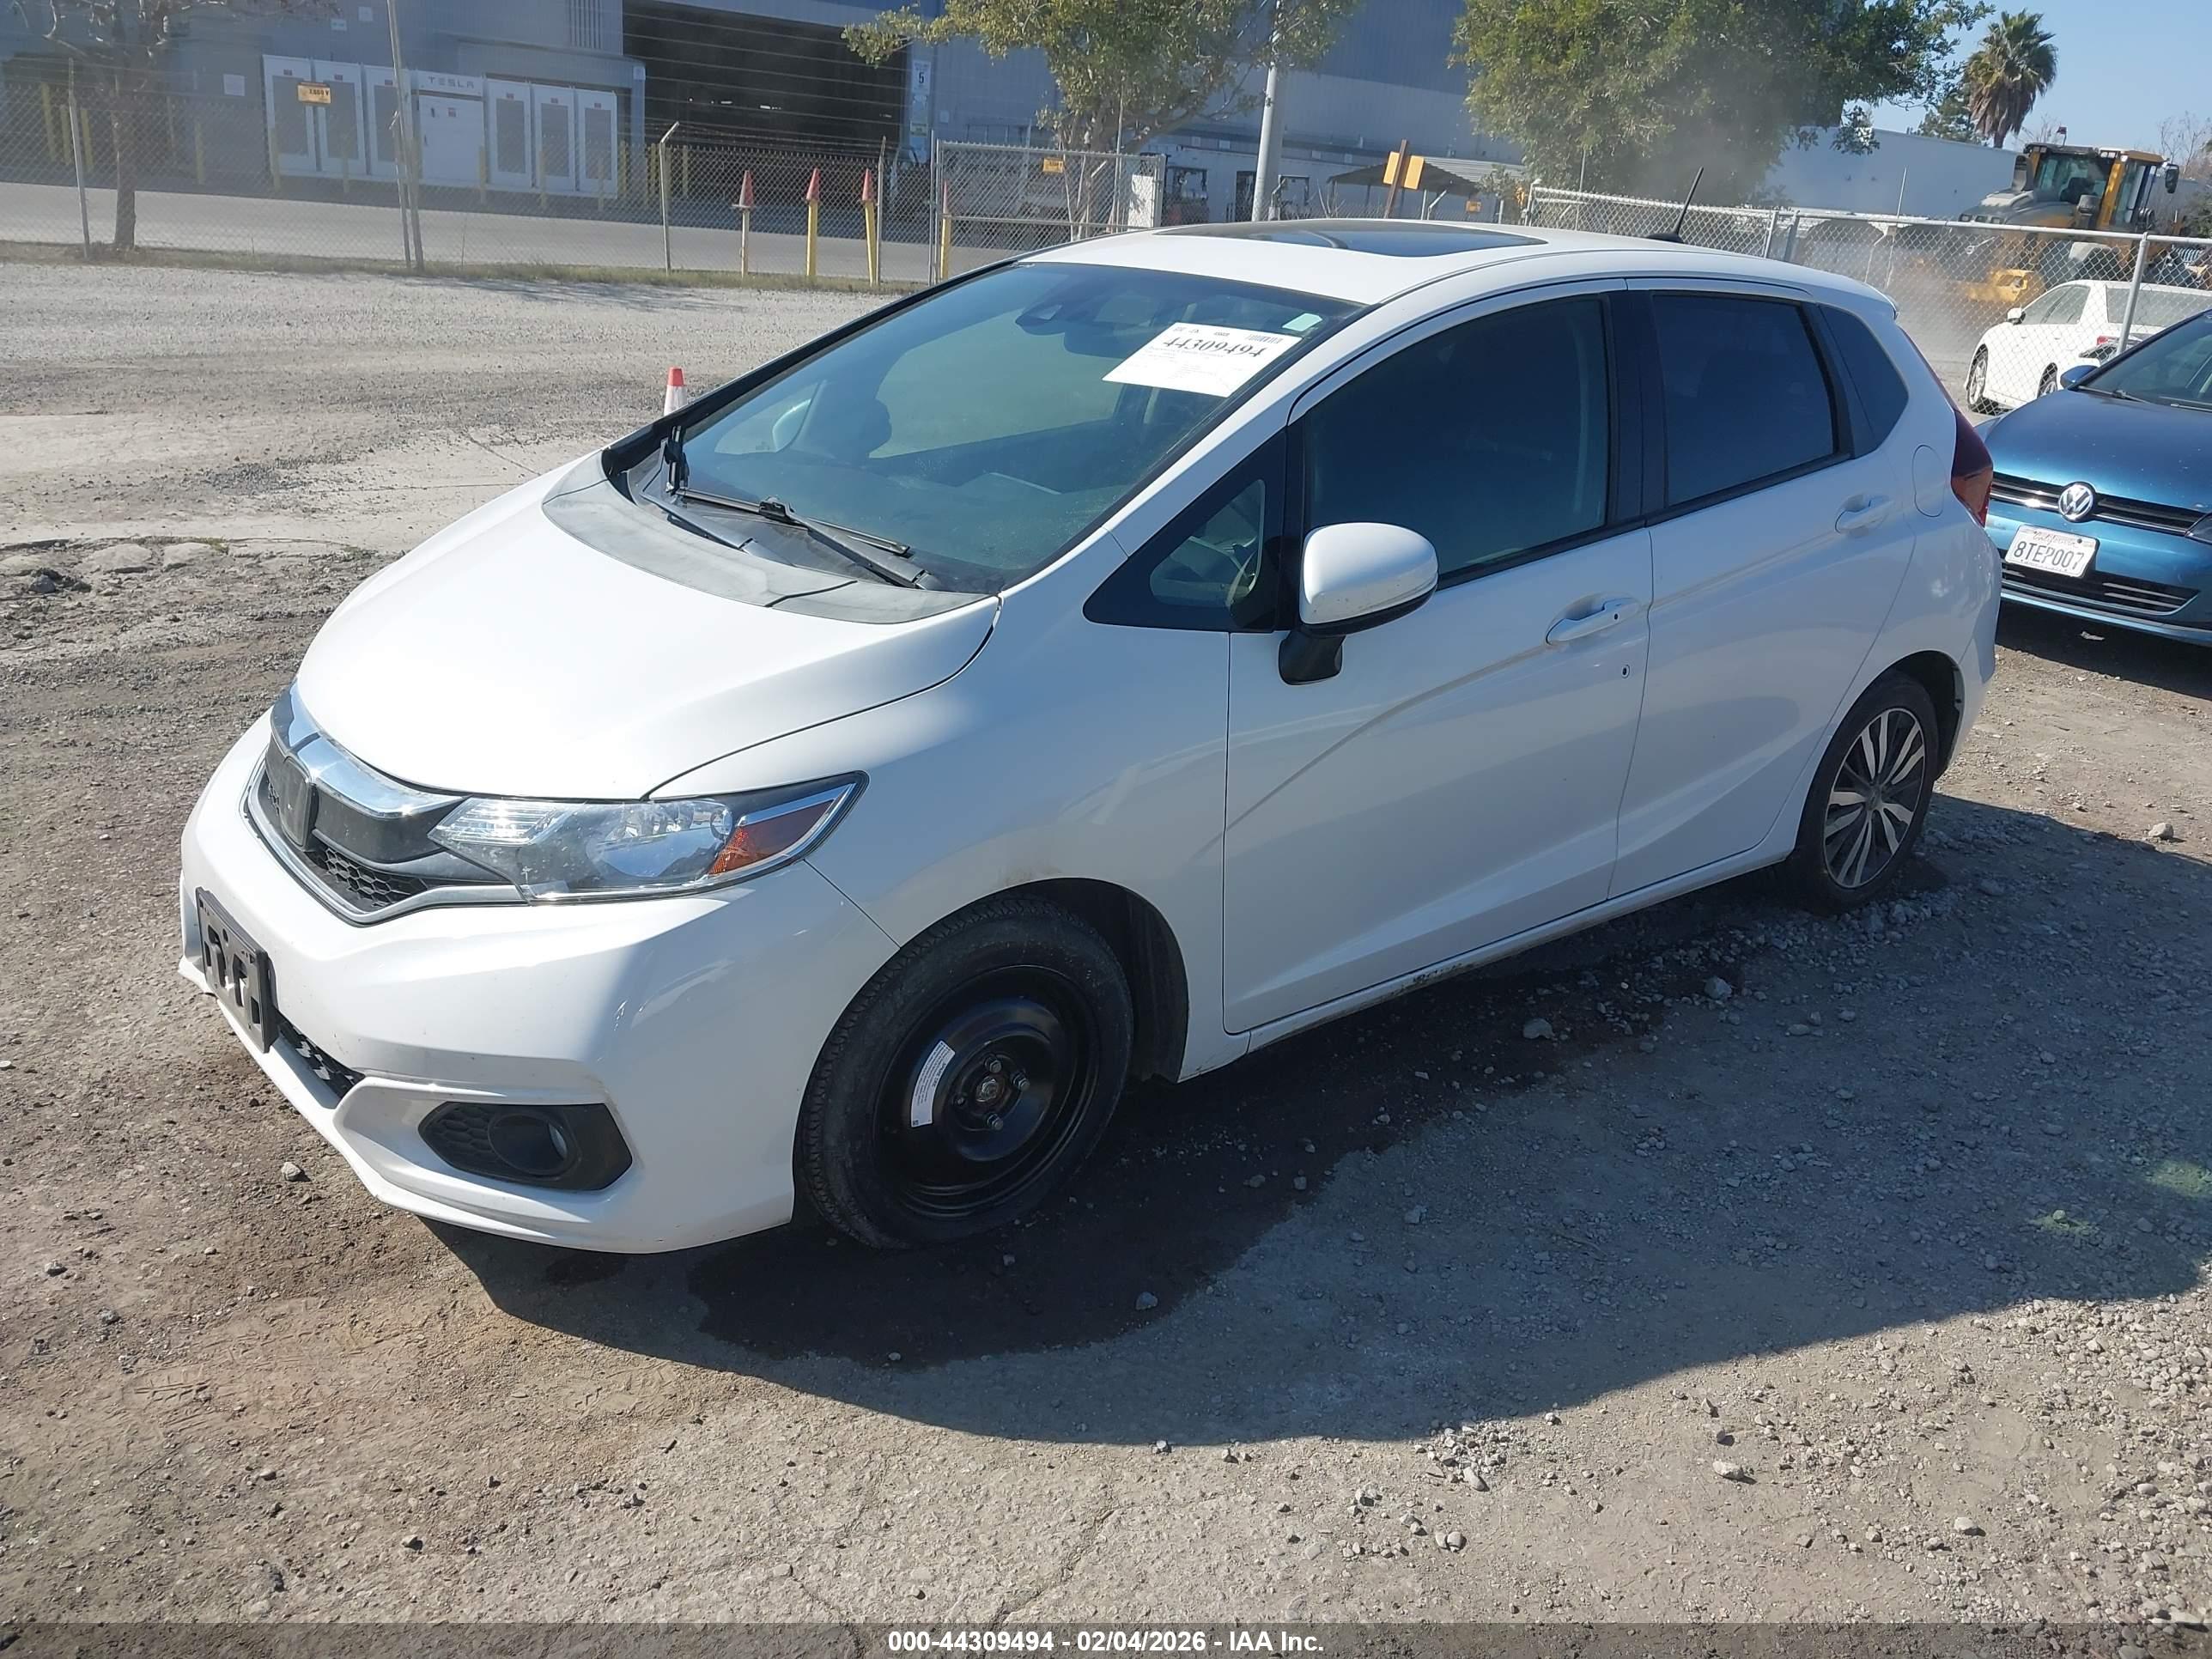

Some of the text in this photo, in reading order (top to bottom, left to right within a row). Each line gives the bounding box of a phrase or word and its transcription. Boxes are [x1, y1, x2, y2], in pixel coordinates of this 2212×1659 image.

[428, 76, 475, 89] TESLA
[918, 71, 925, 84] 5
[1163, 336, 1267, 358] 44309494
[2013, 540, 2085, 570] 8TEP007
